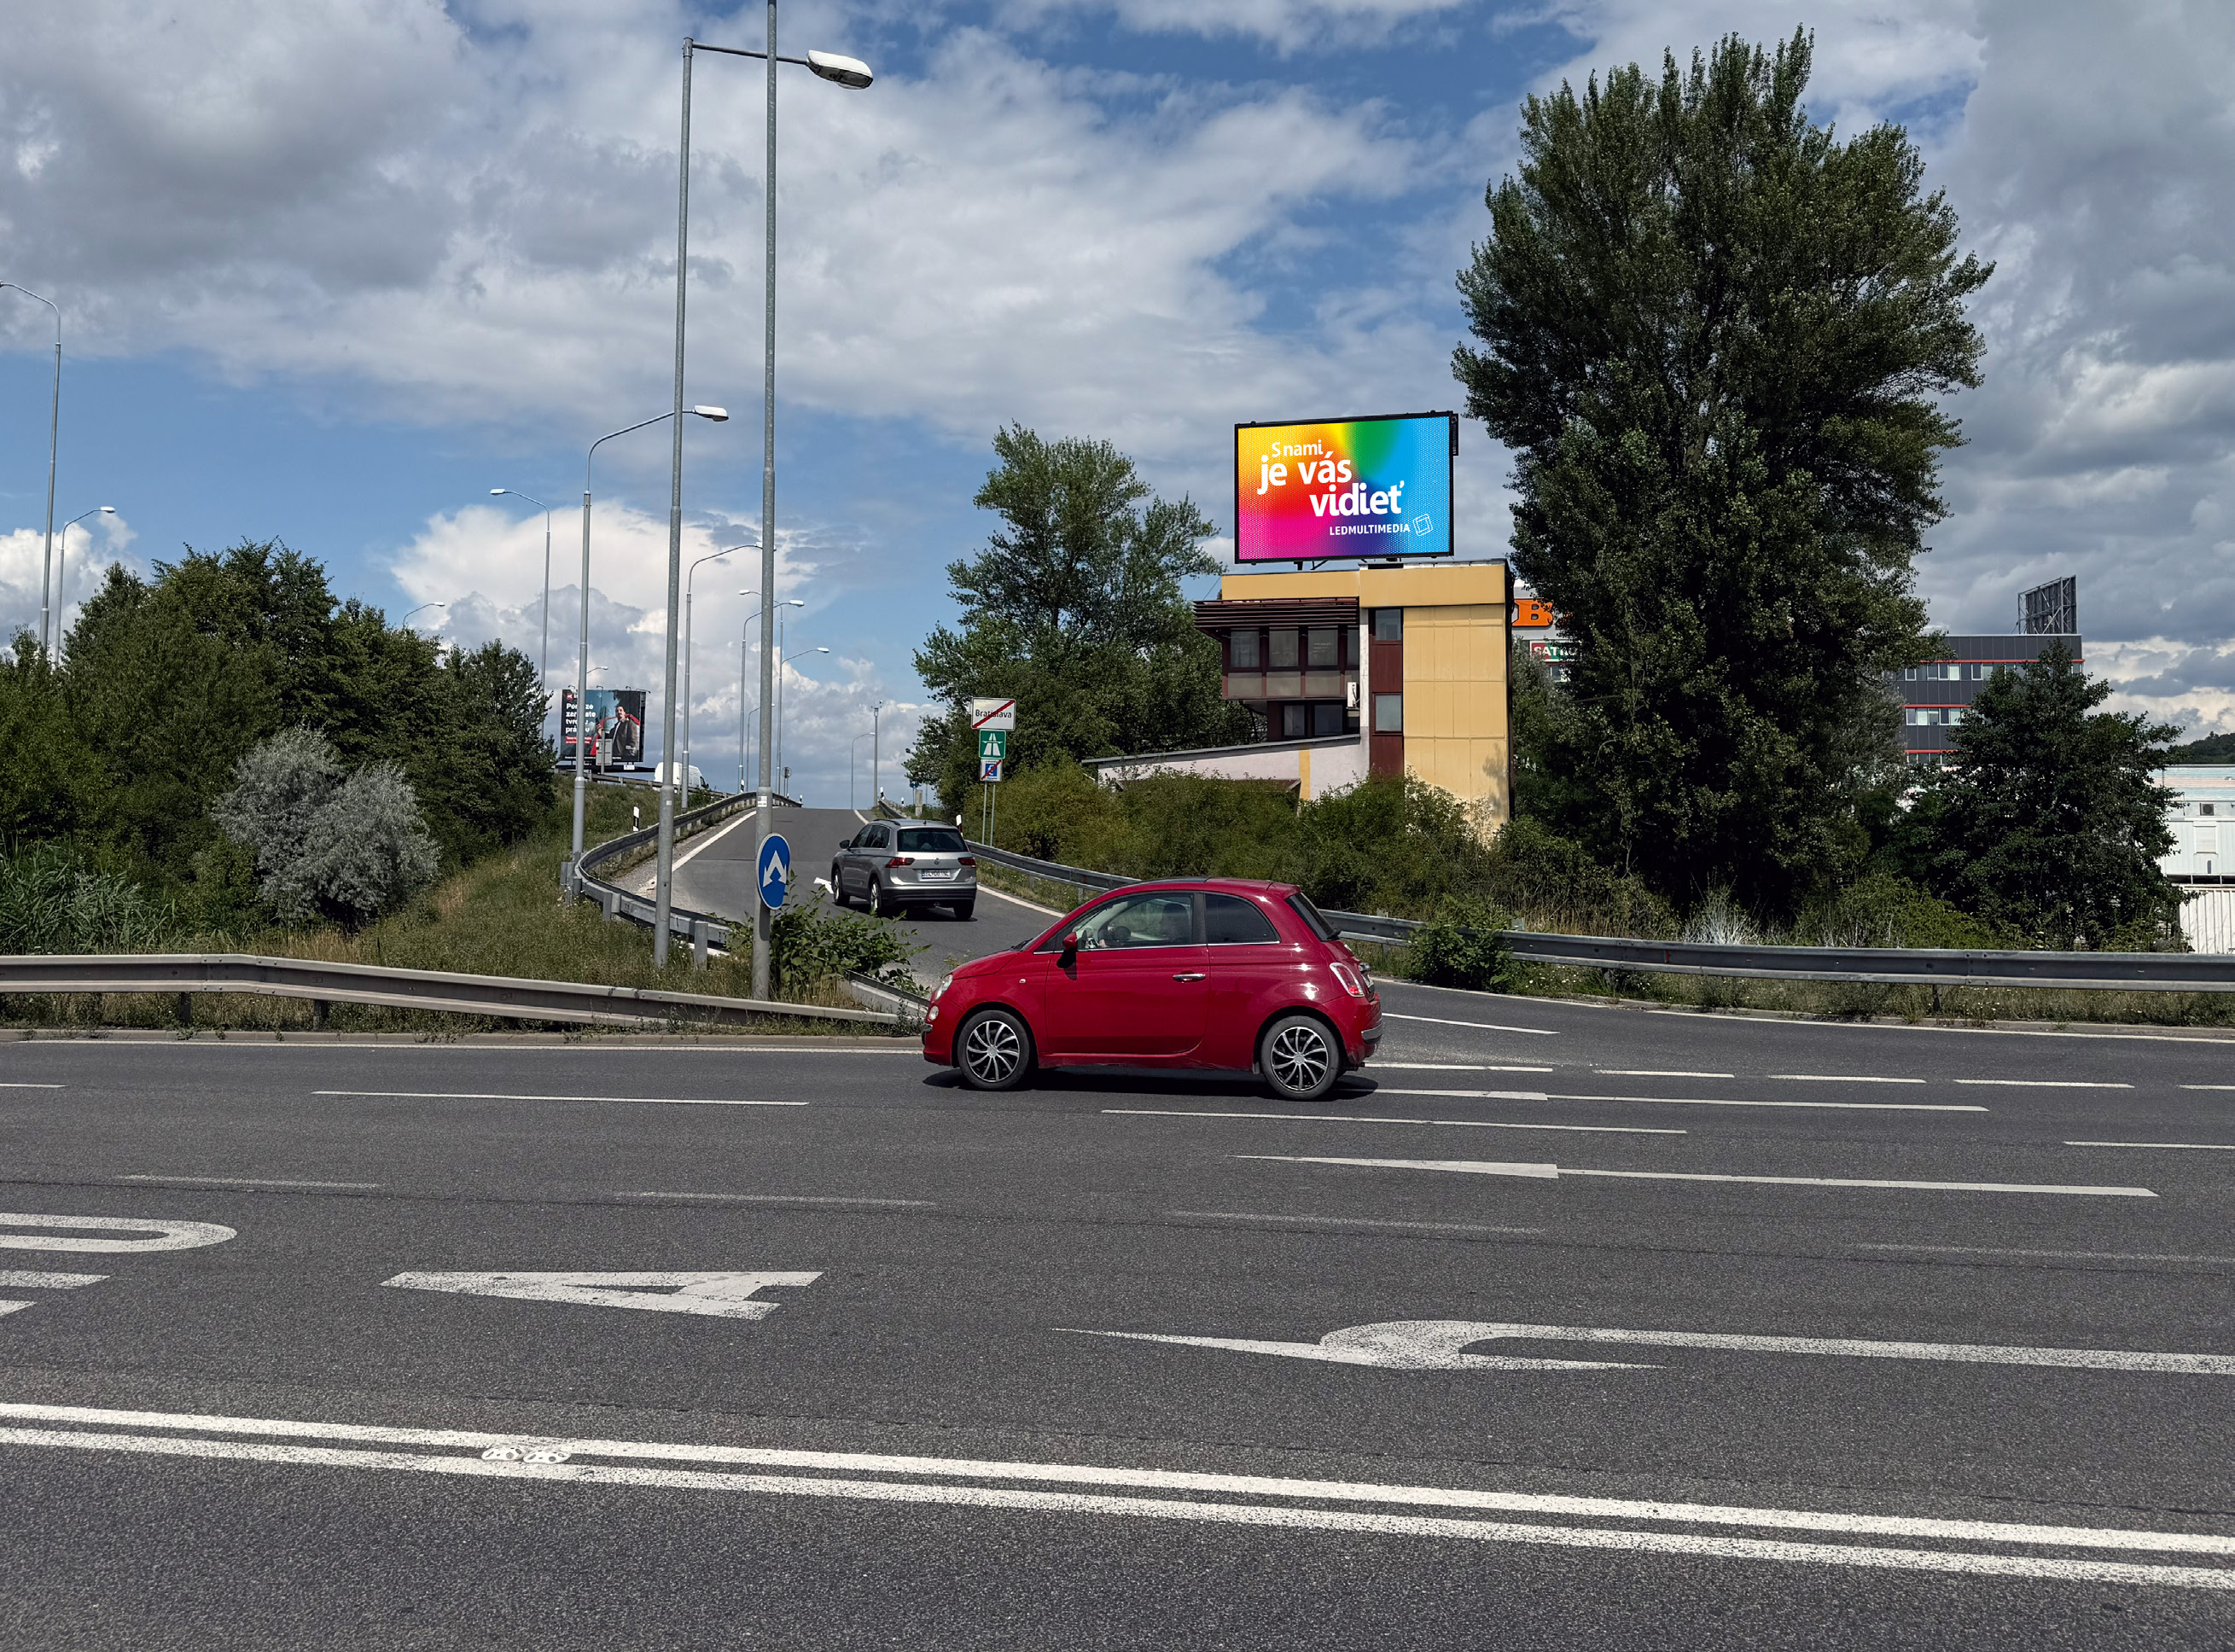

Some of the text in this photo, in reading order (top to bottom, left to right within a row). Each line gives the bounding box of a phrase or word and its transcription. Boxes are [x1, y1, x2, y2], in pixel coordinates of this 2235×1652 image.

[1272, 439, 1324, 457] S nami
[1257, 451, 1353, 495] je vás
[1308, 480, 1405, 517] vidieť
[1329, 523, 1411, 536] LEDMULTIMEDIA
